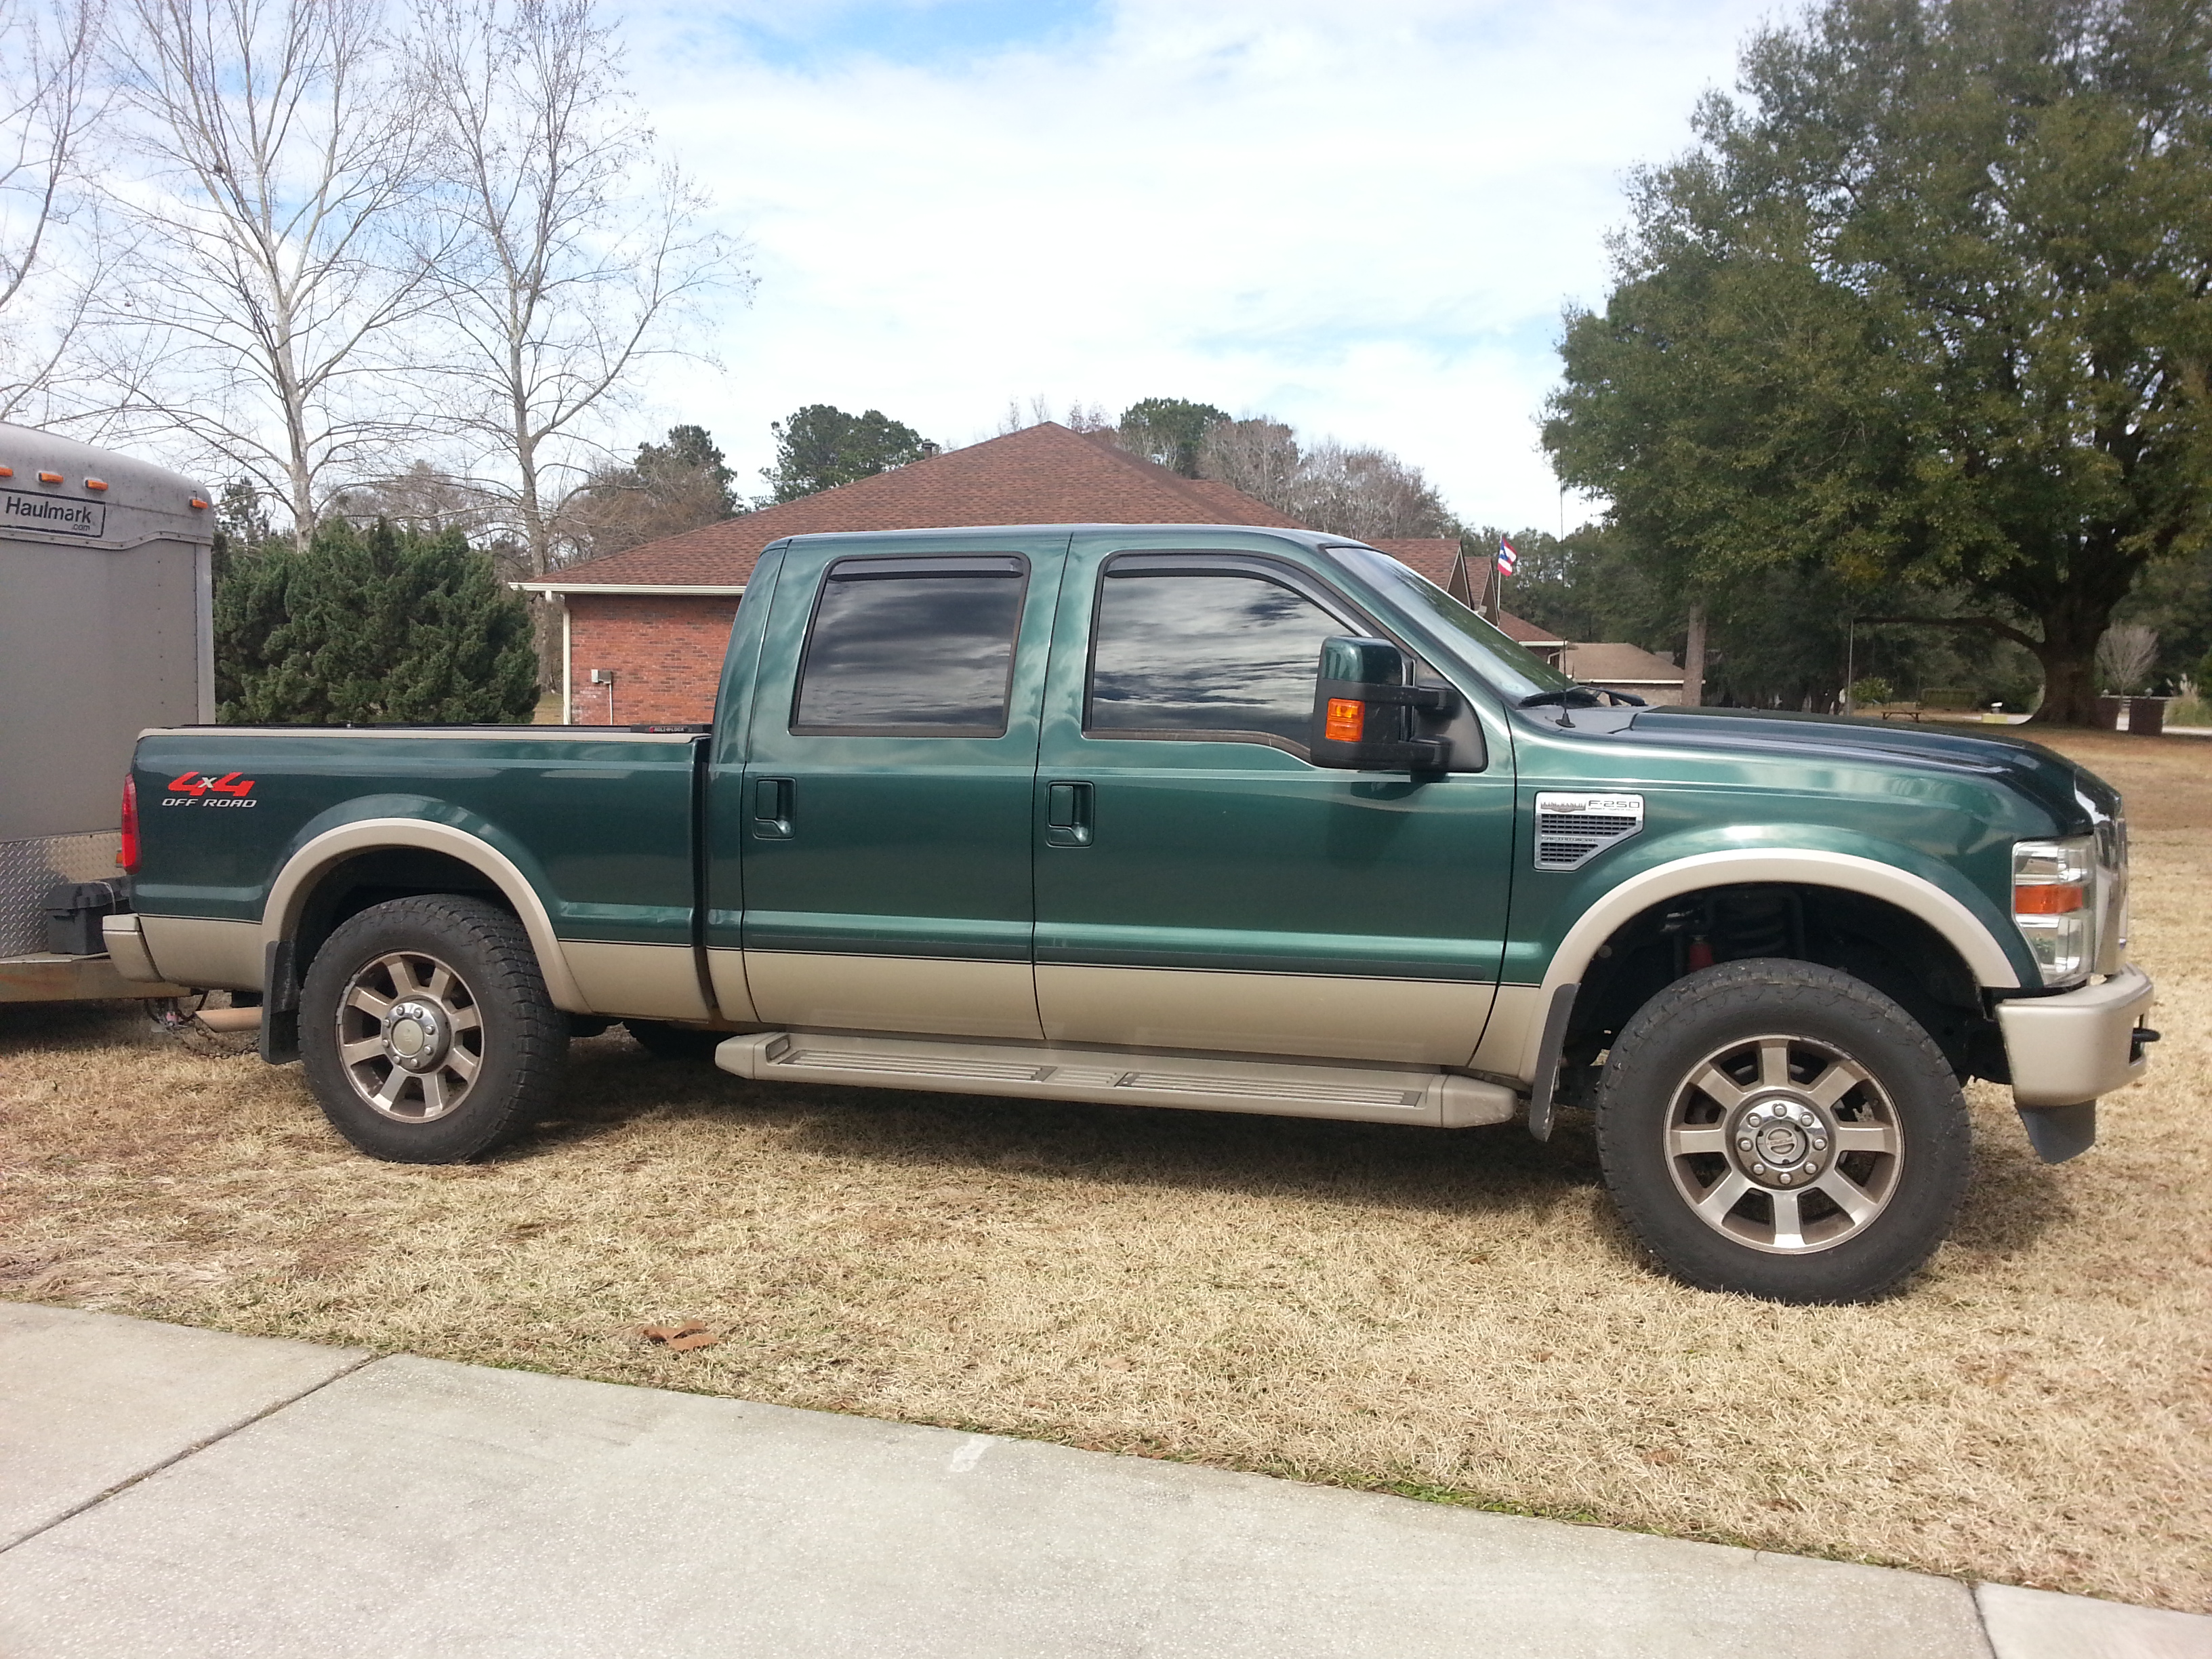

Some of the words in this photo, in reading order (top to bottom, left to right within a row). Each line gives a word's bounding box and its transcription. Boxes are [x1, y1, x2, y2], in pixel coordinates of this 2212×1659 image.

[5, 496, 92, 524] Haulmark
[71, 523, 90, 531] .com
[168, 771, 255, 797] 4x4
[162, 798, 199, 806] OFF
[203, 799, 257, 808] ROAD
[1589, 800, 1640, 808] F-250
